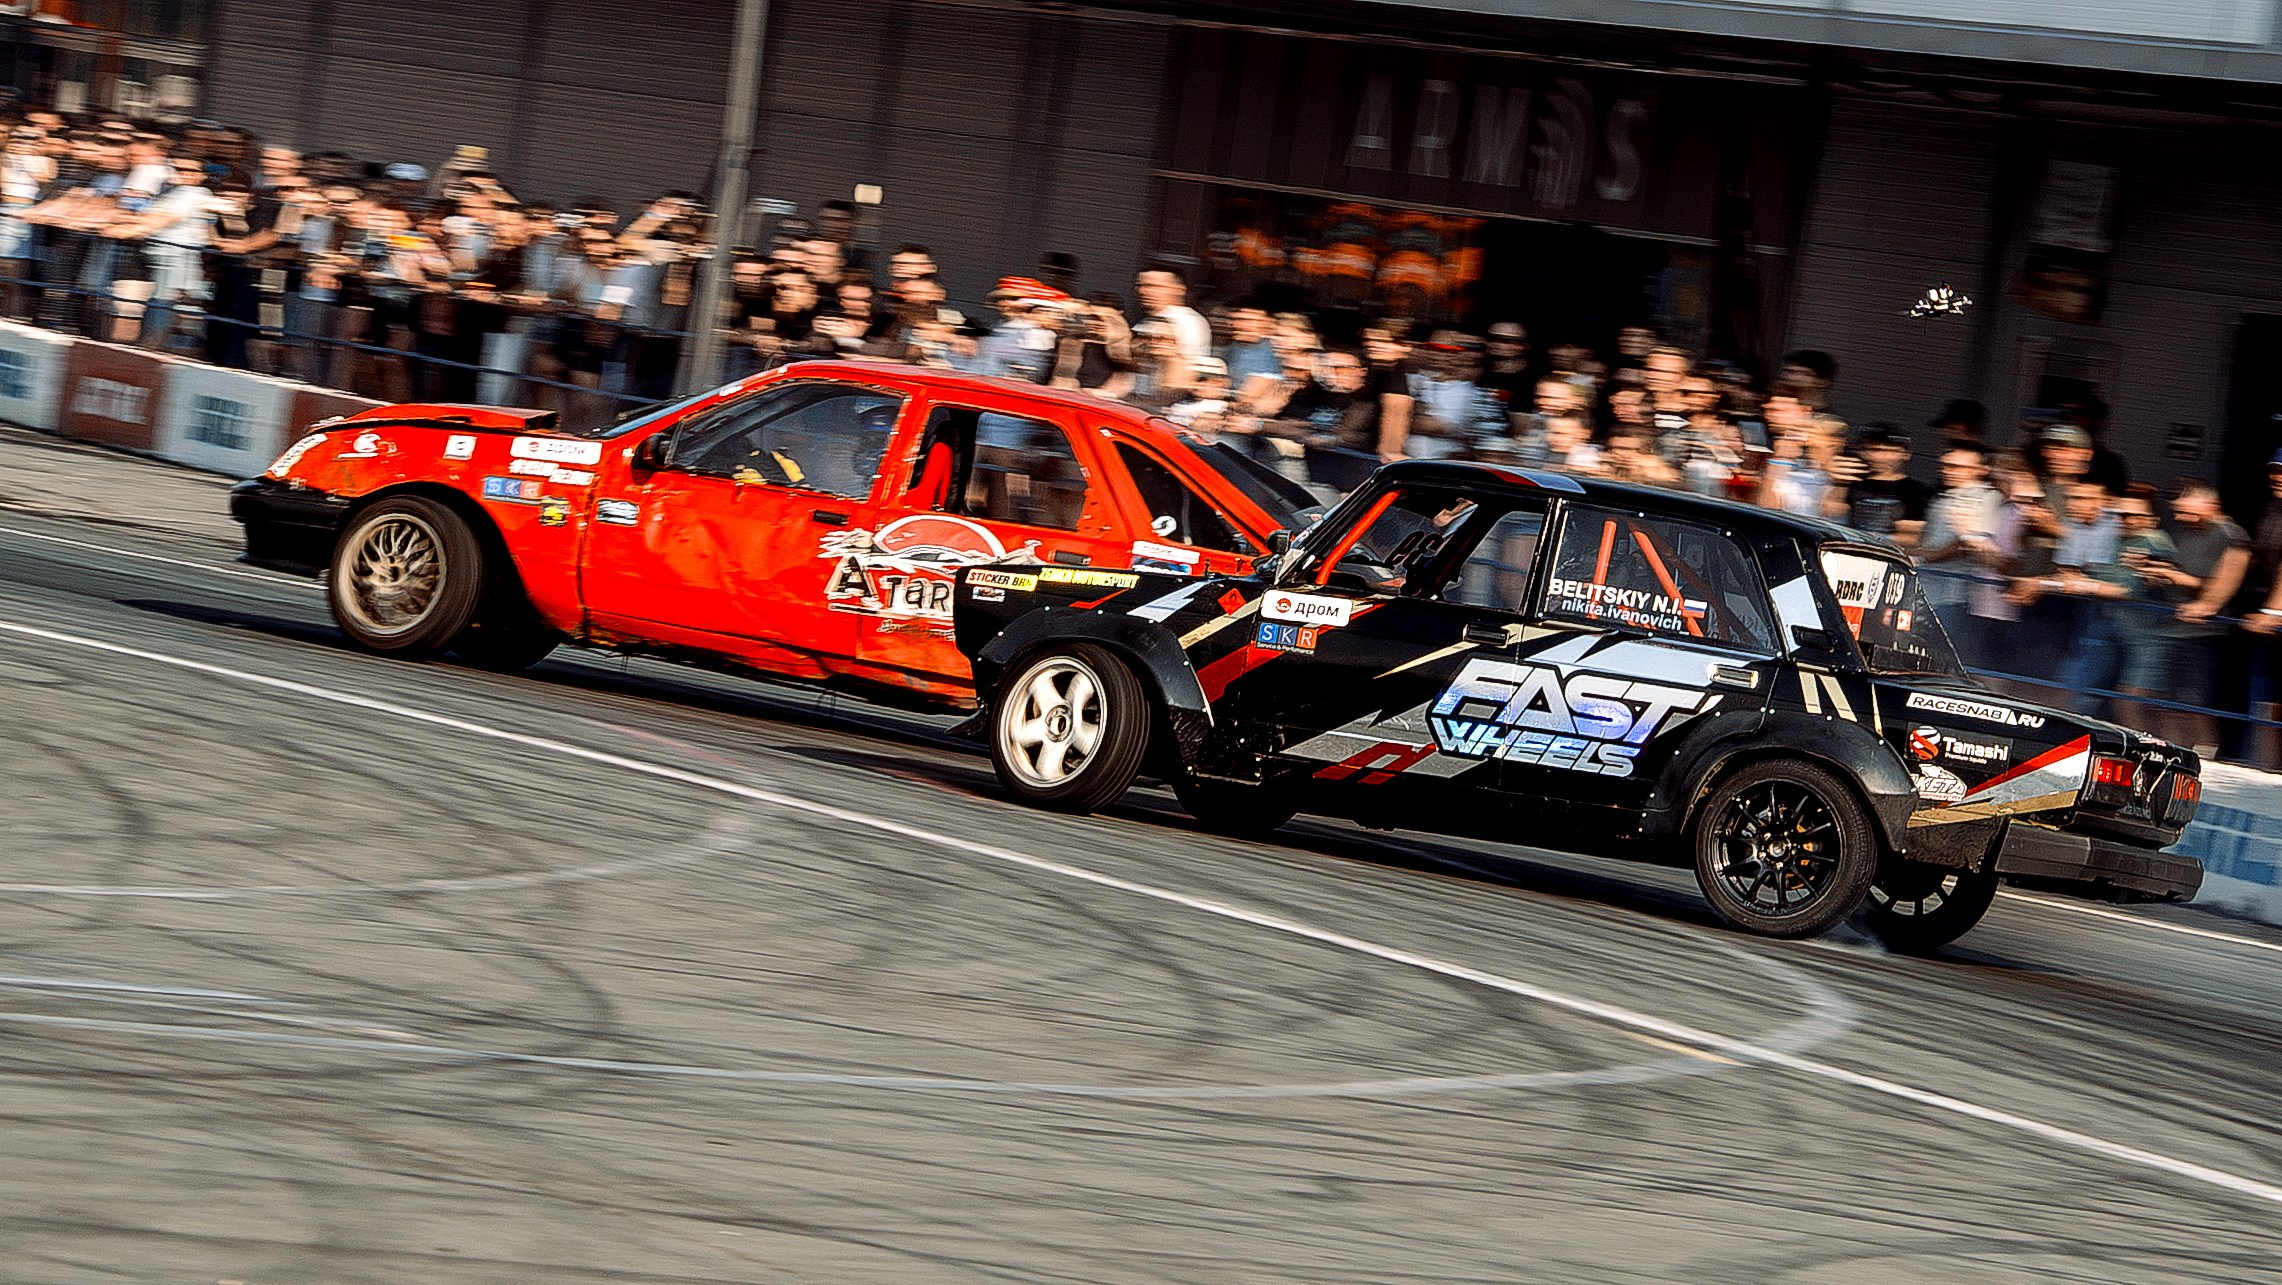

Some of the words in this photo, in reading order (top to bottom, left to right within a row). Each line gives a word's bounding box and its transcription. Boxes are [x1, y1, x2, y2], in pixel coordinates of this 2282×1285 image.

[969, 571, 1010, 585] STICKER
[1294, 602, 1340, 618] дром
[1549, 578, 1651, 609] BELITSKIY
[1652, 595, 1682, 616] N.I.
[1261, 624, 1313, 647] SKR
[1432, 657, 1708, 744] FAST
[1912, 696, 2003, 720] RACESNAB
[2017, 713, 2046, 729] RU
[1431, 716, 1643, 777] WHEELS
[1943, 736, 2009, 761] Tamashi
